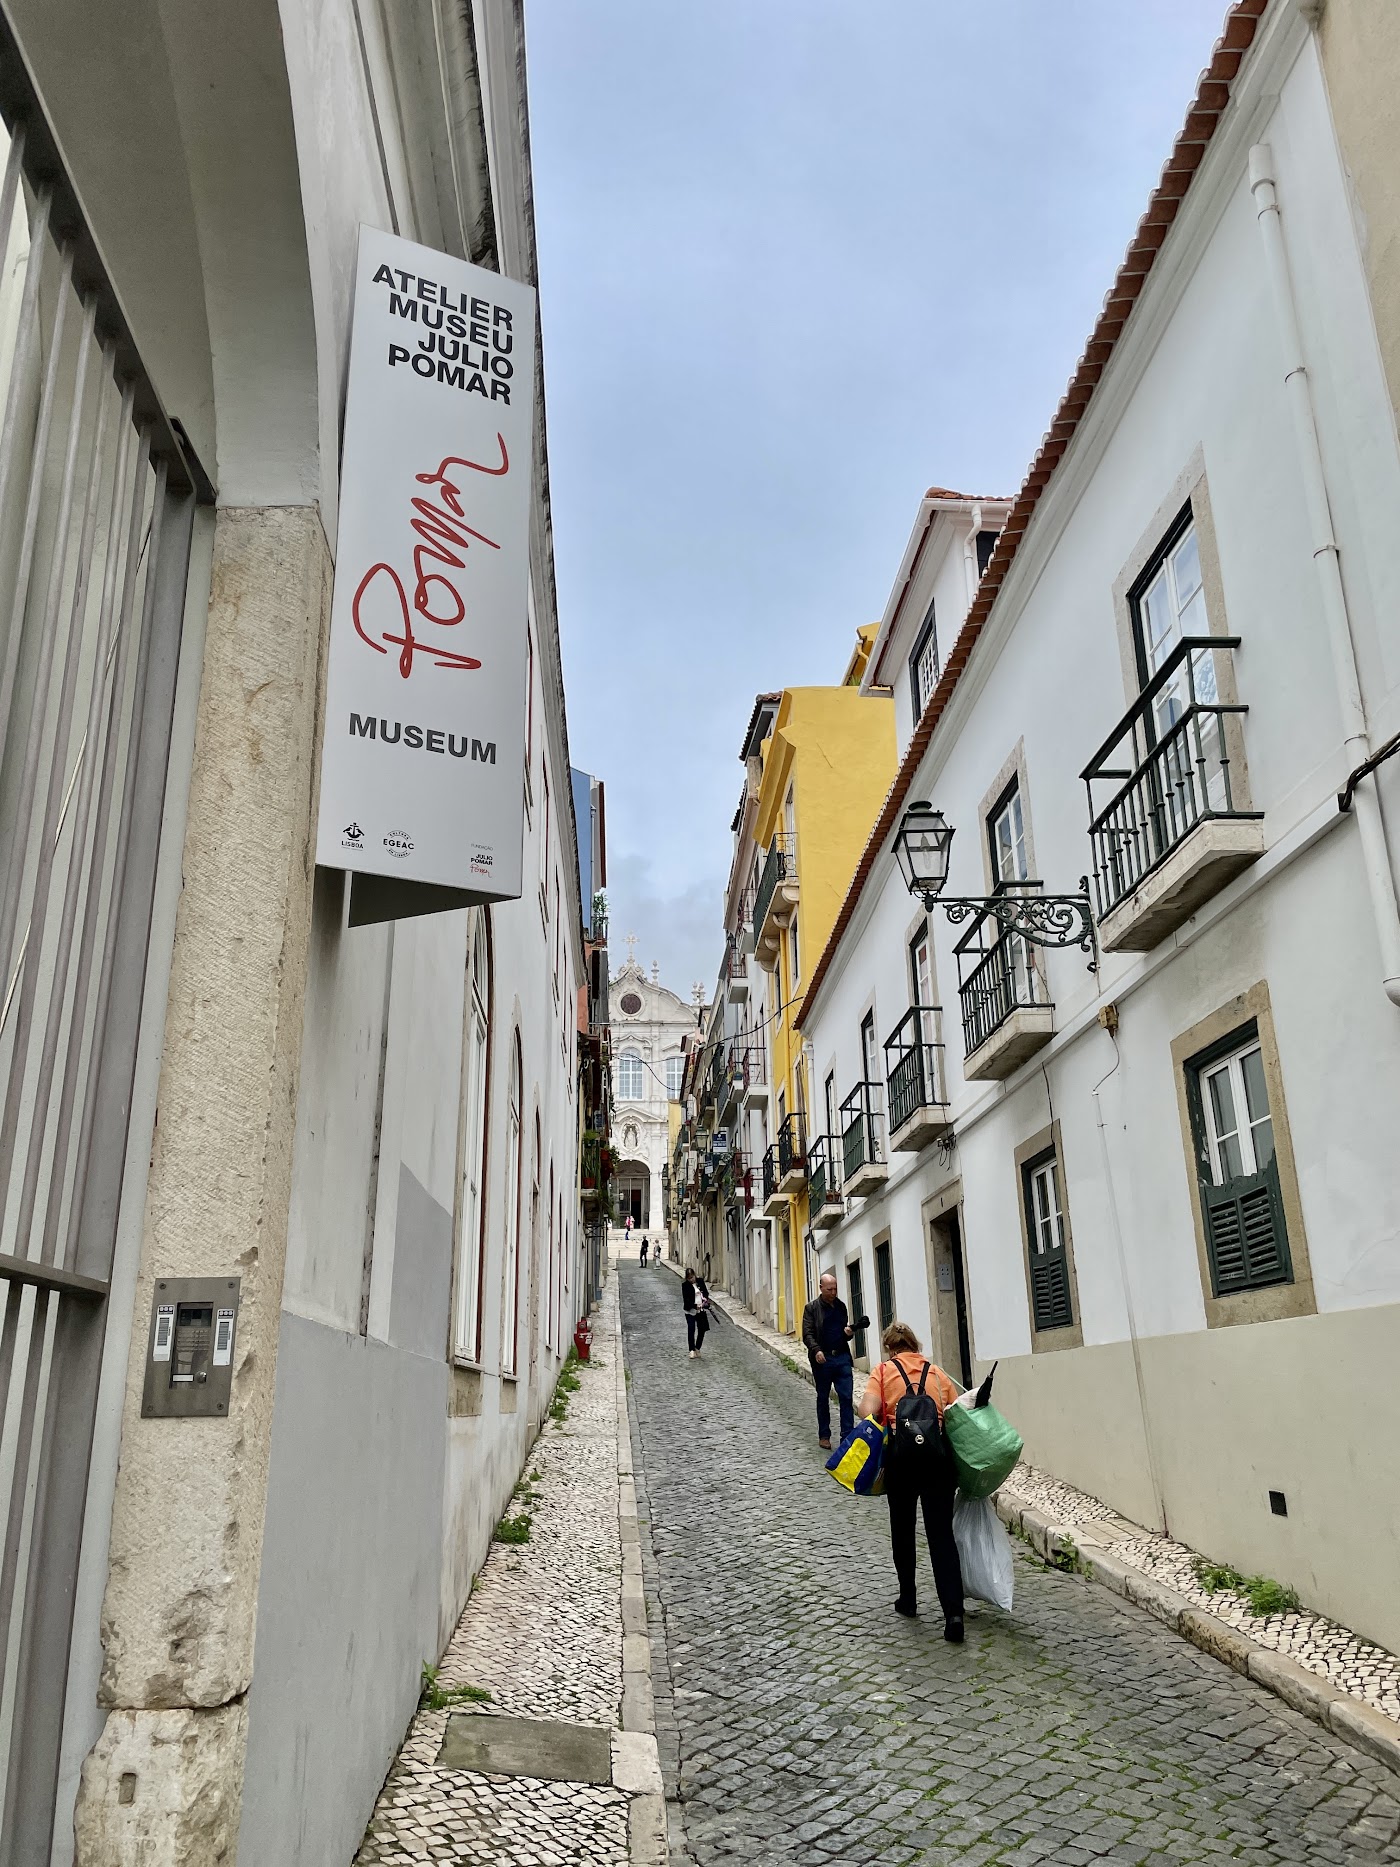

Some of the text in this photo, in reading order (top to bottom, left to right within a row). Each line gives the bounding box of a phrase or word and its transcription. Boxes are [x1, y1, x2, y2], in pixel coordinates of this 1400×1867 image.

[372, 264, 513, 332] ATELIER
[389, 292, 513, 355] MUSEU
[388, 343, 511, 405] POMAR
[349, 712, 497, 765] MUSEUM
[341, 840, 364, 849] LISBOA
[383, 838, 415, 850] EGEAC
[470, 857, 493, 866] POMAR
